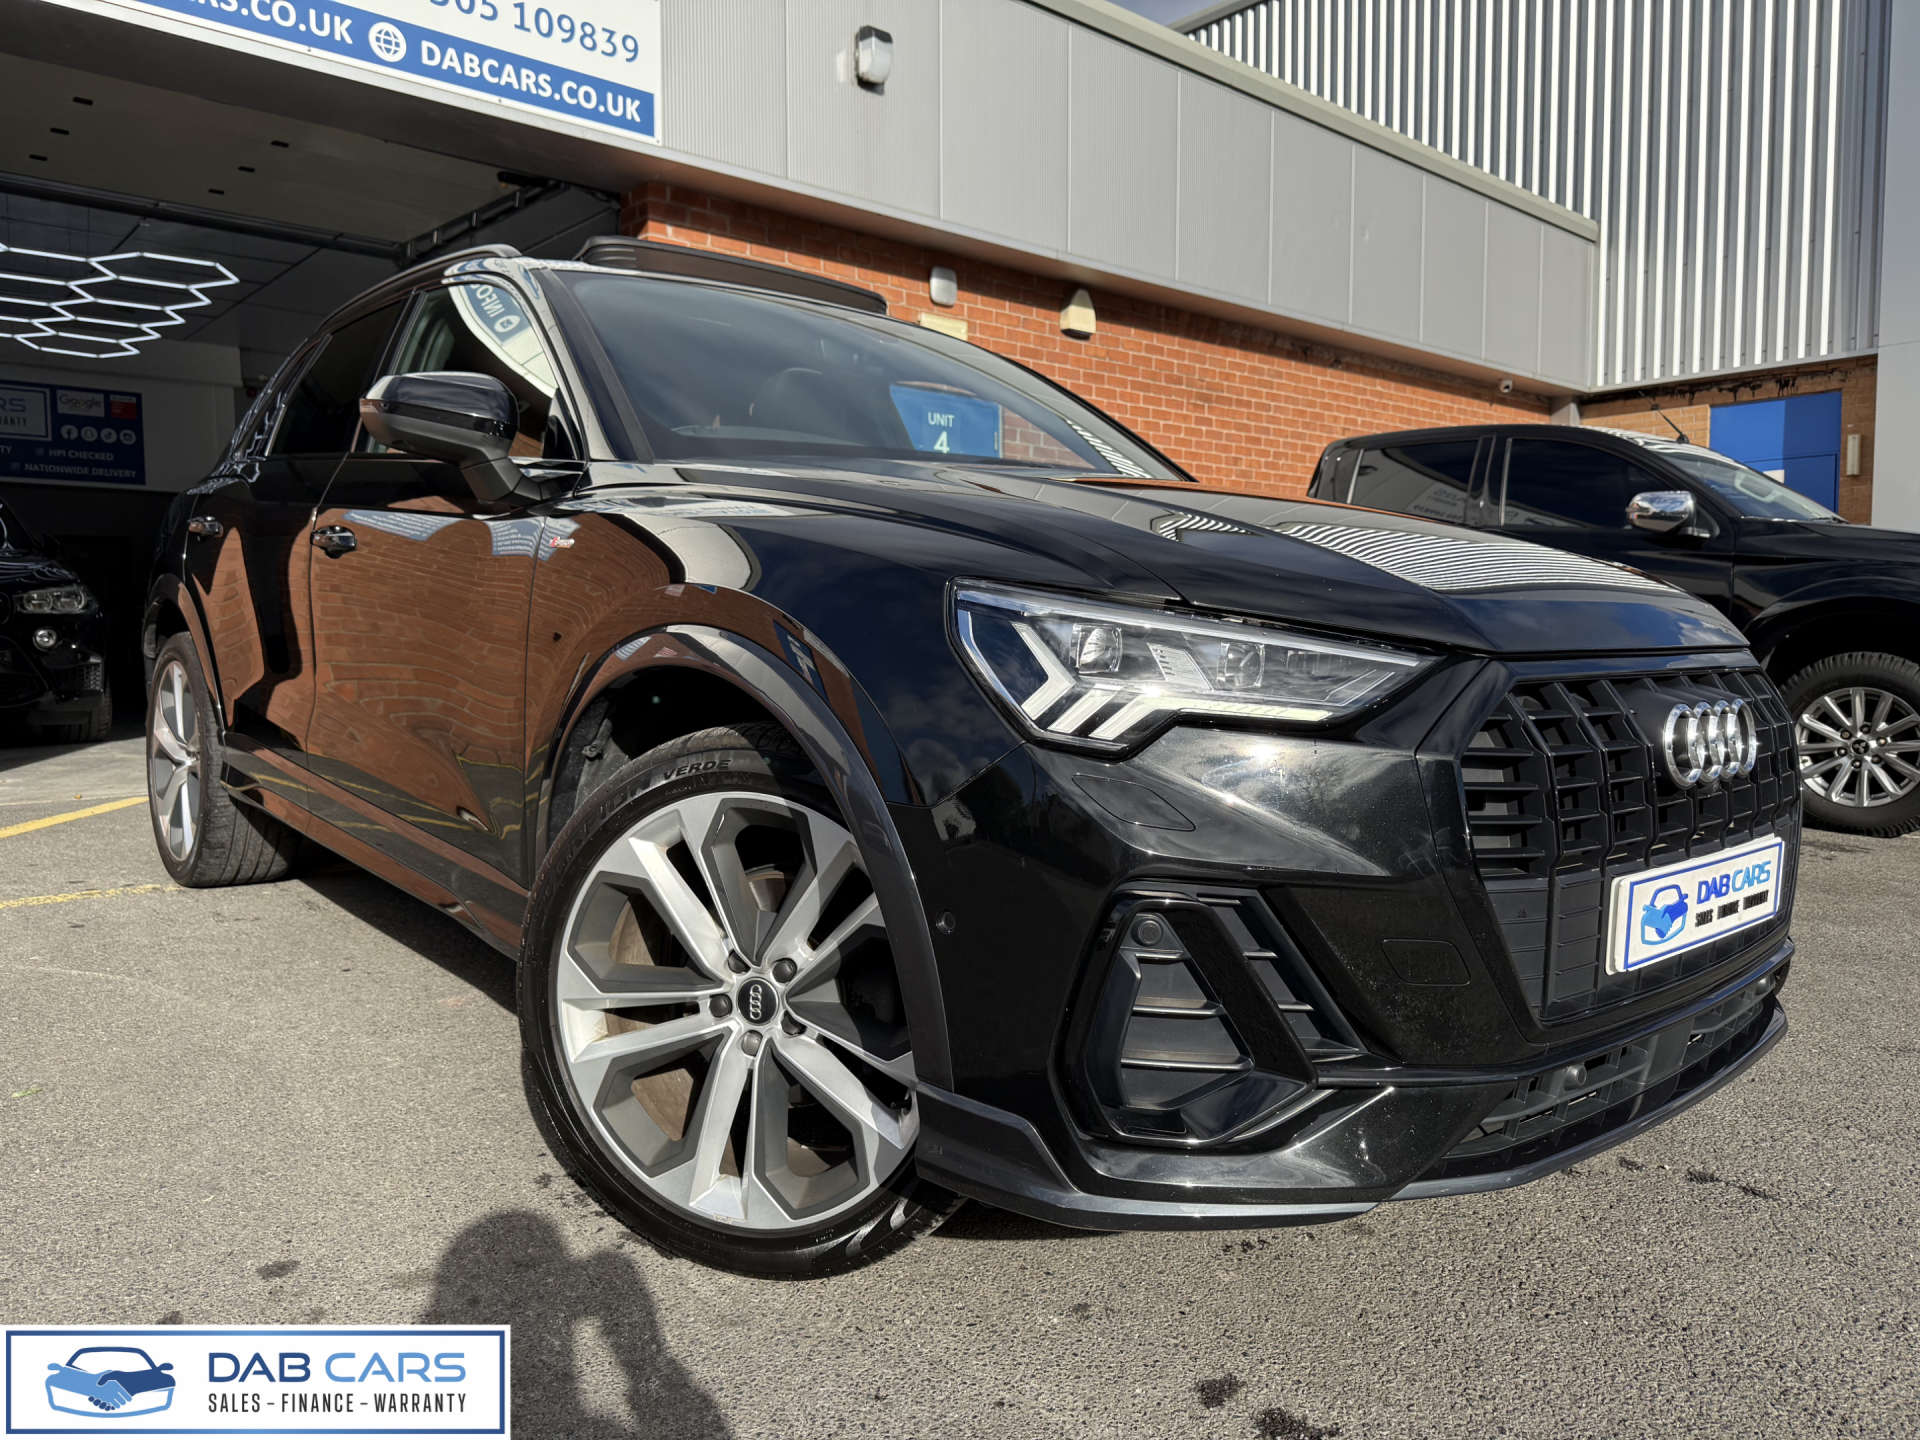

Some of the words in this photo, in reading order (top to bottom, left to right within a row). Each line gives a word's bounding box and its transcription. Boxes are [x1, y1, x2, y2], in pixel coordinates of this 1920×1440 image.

[513, 1, 639, 62] 109839
[420, 40, 641, 122] DABCARS.CO.UK
[927, 411, 955, 428] UNIT
[933, 430, 950, 454] 4
[68, 450, 114, 461] CHECKED
[24, 463, 89, 476] NATIONWIDE
[91, 466, 136, 478] DELIVERY
[663, 759, 731, 780] VERDE
[1697, 874, 1731, 904] DAB
[1732, 860, 1772, 893] CARS
